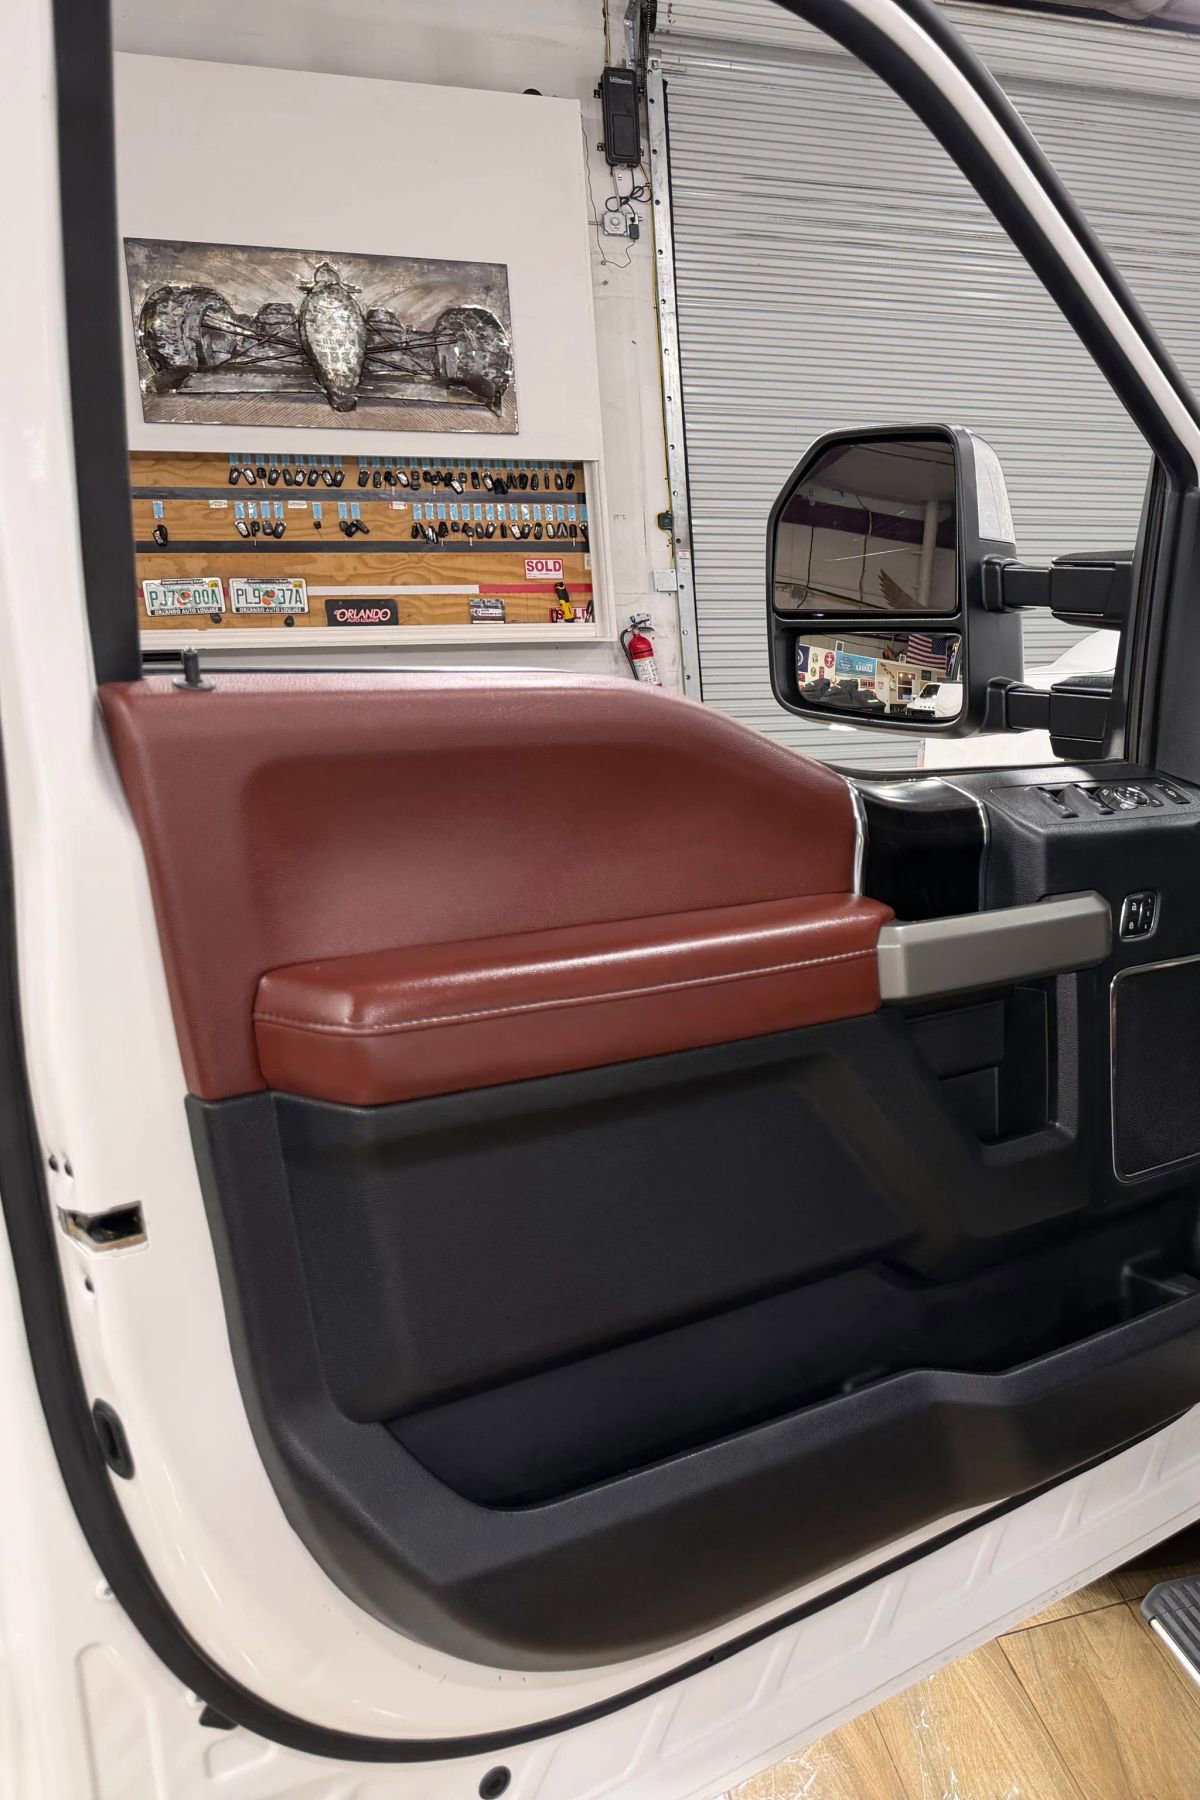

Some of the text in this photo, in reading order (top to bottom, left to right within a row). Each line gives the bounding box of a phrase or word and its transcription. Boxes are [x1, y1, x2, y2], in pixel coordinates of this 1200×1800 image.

[526, 560, 562, 572] SOLD
[335, 608, 391, 621] ORLANDO
[557, 608, 587, 620] SL
